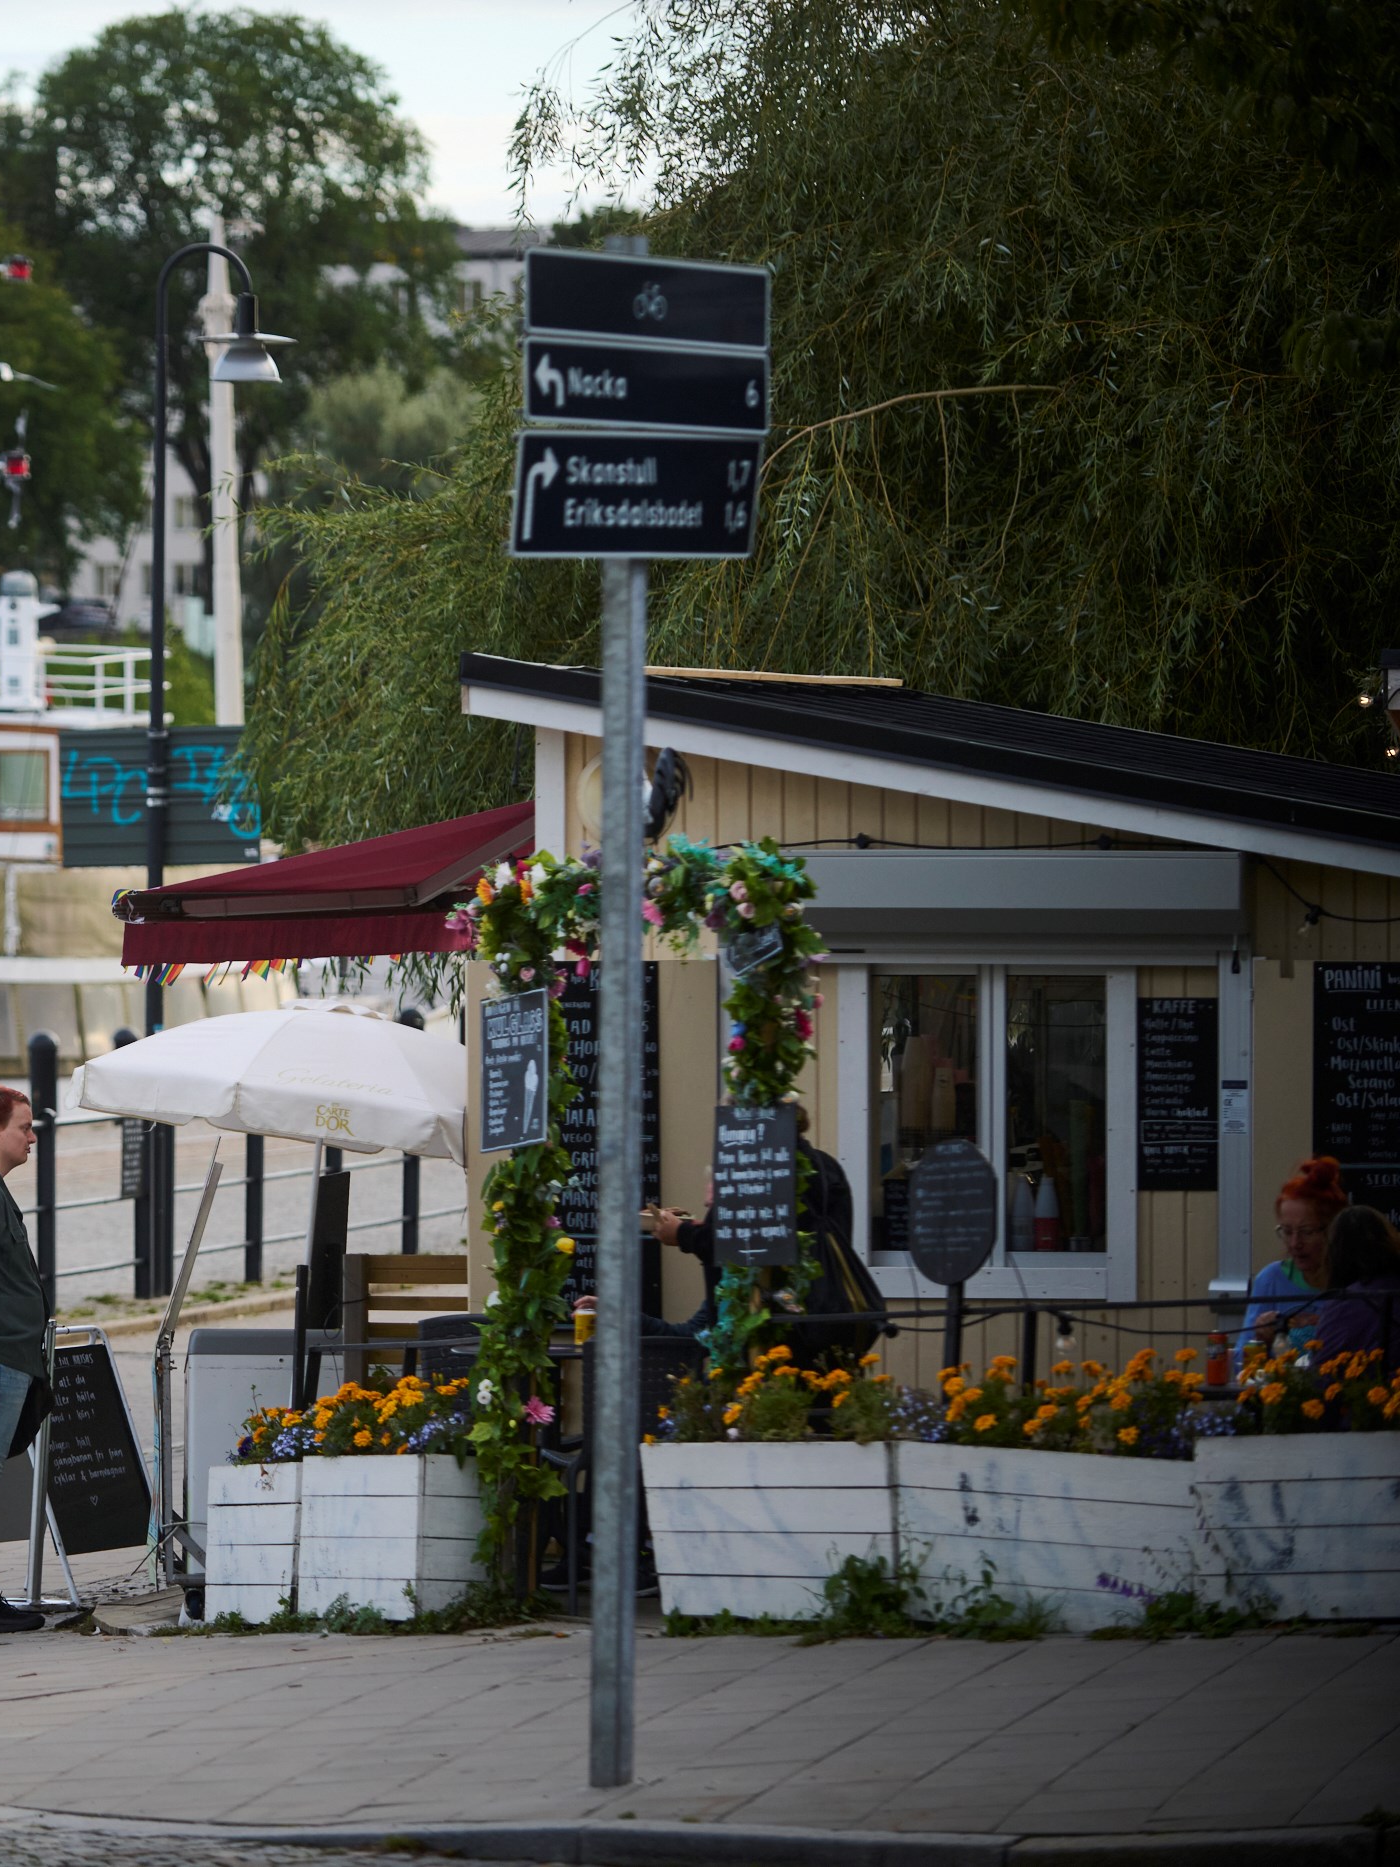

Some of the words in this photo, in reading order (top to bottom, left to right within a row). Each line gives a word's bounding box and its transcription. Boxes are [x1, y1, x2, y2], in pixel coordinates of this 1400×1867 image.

[567, 366, 628, 400] Nacka
[745, 379, 760, 408] 6
[565, 455, 658, 486] Skanstull
[727, 459, 752, 493] 1,7
[563, 498, 703, 528] Eriksdalsbadet
[1152, 1000, 1196, 1014] KAFFE
[1332, 1016, 1357, 1032] Ost
[276, 1068, 393, 1096] Gelateria
[316, 1104, 351, 1117] CARTE
[562, 1133, 592, 1143] VEGO
[58, 1376, 72, 1389] att
[75, 1373, 86, 1386] du
[76, 1391, 97, 1404] hålla
[75, 1436, 92, 1449] håll
[53, 1452, 93, 1470] gångbanan
[108, 1448, 124, 1461] från
[54, 1472, 77, 1486] cyklar
